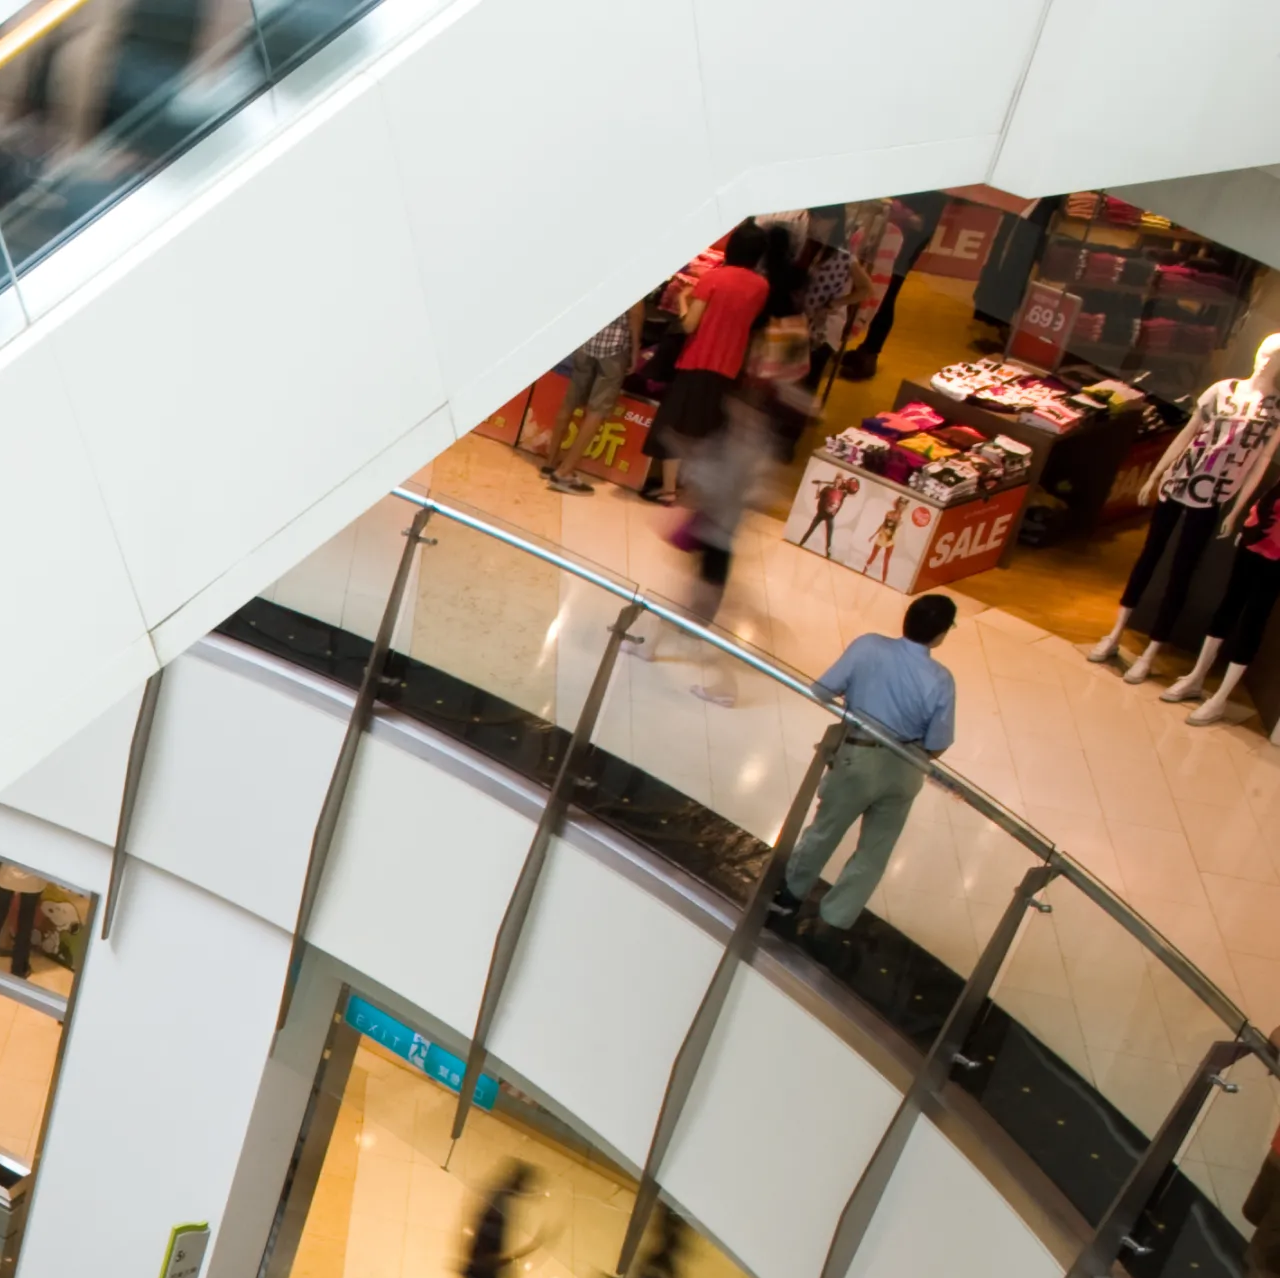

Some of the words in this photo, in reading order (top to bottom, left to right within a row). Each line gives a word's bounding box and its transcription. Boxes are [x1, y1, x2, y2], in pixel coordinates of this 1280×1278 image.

[625, 411, 653, 428] SALE
[929, 513, 1013, 568] SALE
[356, 1014, 400, 1047] EXIT
